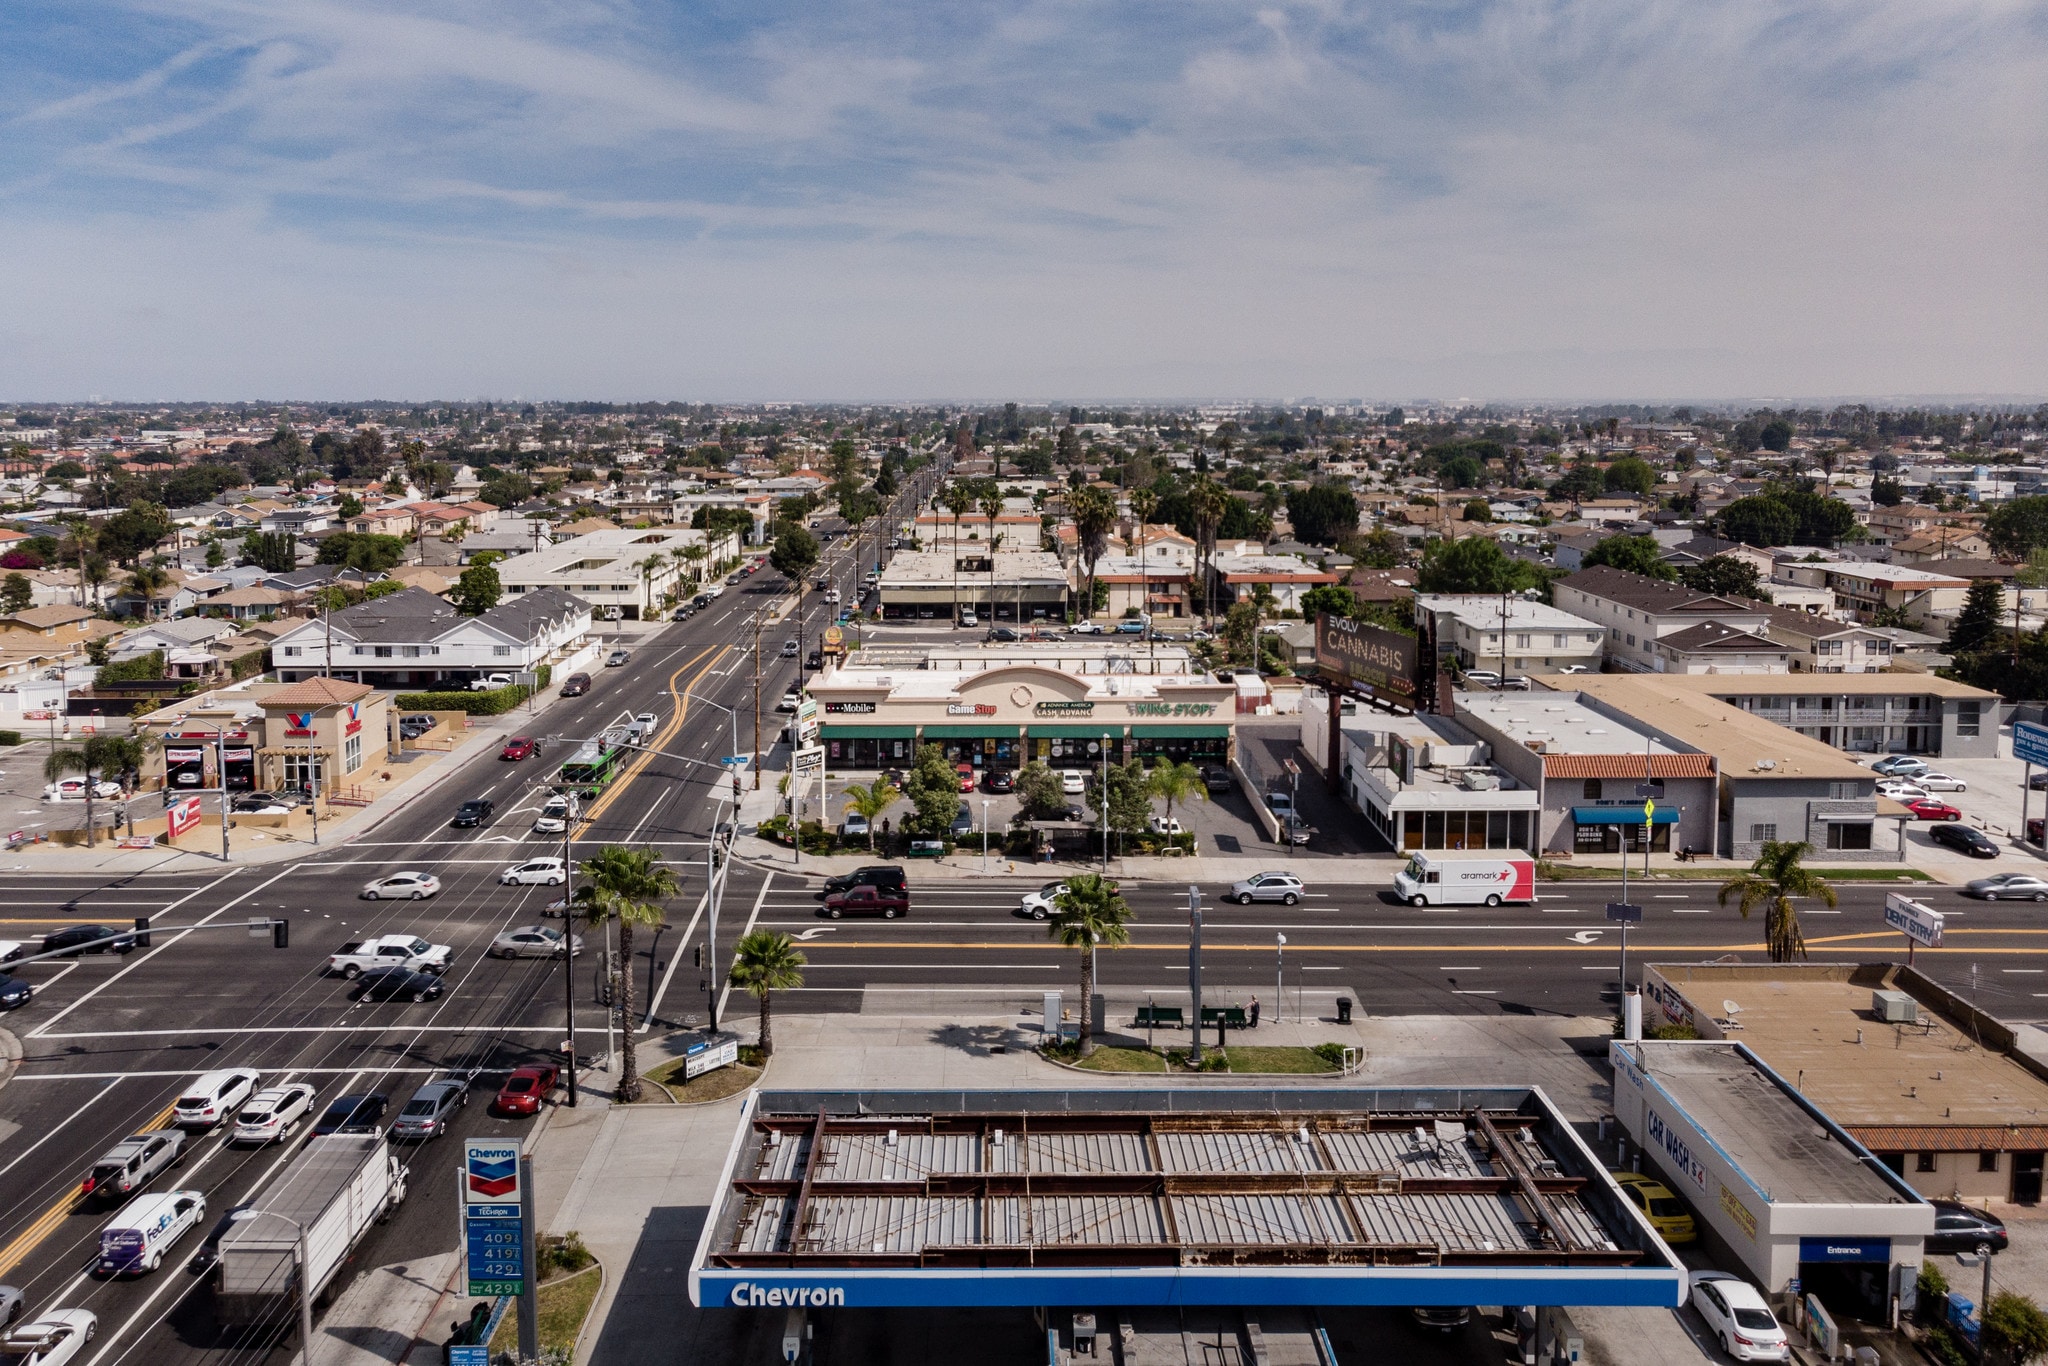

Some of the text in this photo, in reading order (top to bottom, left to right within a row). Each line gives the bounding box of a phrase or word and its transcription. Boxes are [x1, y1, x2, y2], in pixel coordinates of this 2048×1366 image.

[1329, 615, 1359, 633] EVOLV
[1327, 630, 1402, 671] CANNABIS
[948, 704, 997, 715] GameStop
[1136, 703, 1211, 714] WING STOP
[1614, 1054, 1644, 1091] Car Wash
[1648, 1110, 1664, 1148] CAR
[1666, 1127, 1689, 1175] WASH
[468, 1148, 516, 1158] Chevron
[147, 1213, 173, 1244] FedEx
[484, 1233, 512, 1243] 409
[484, 1249, 513, 1259] 419
[1827, 1246, 1862, 1255] Entrance
[485, 1264, 513, 1274] 429
[484, 1284, 512, 1294] 429
[731, 1282, 845, 1306] Chevron
